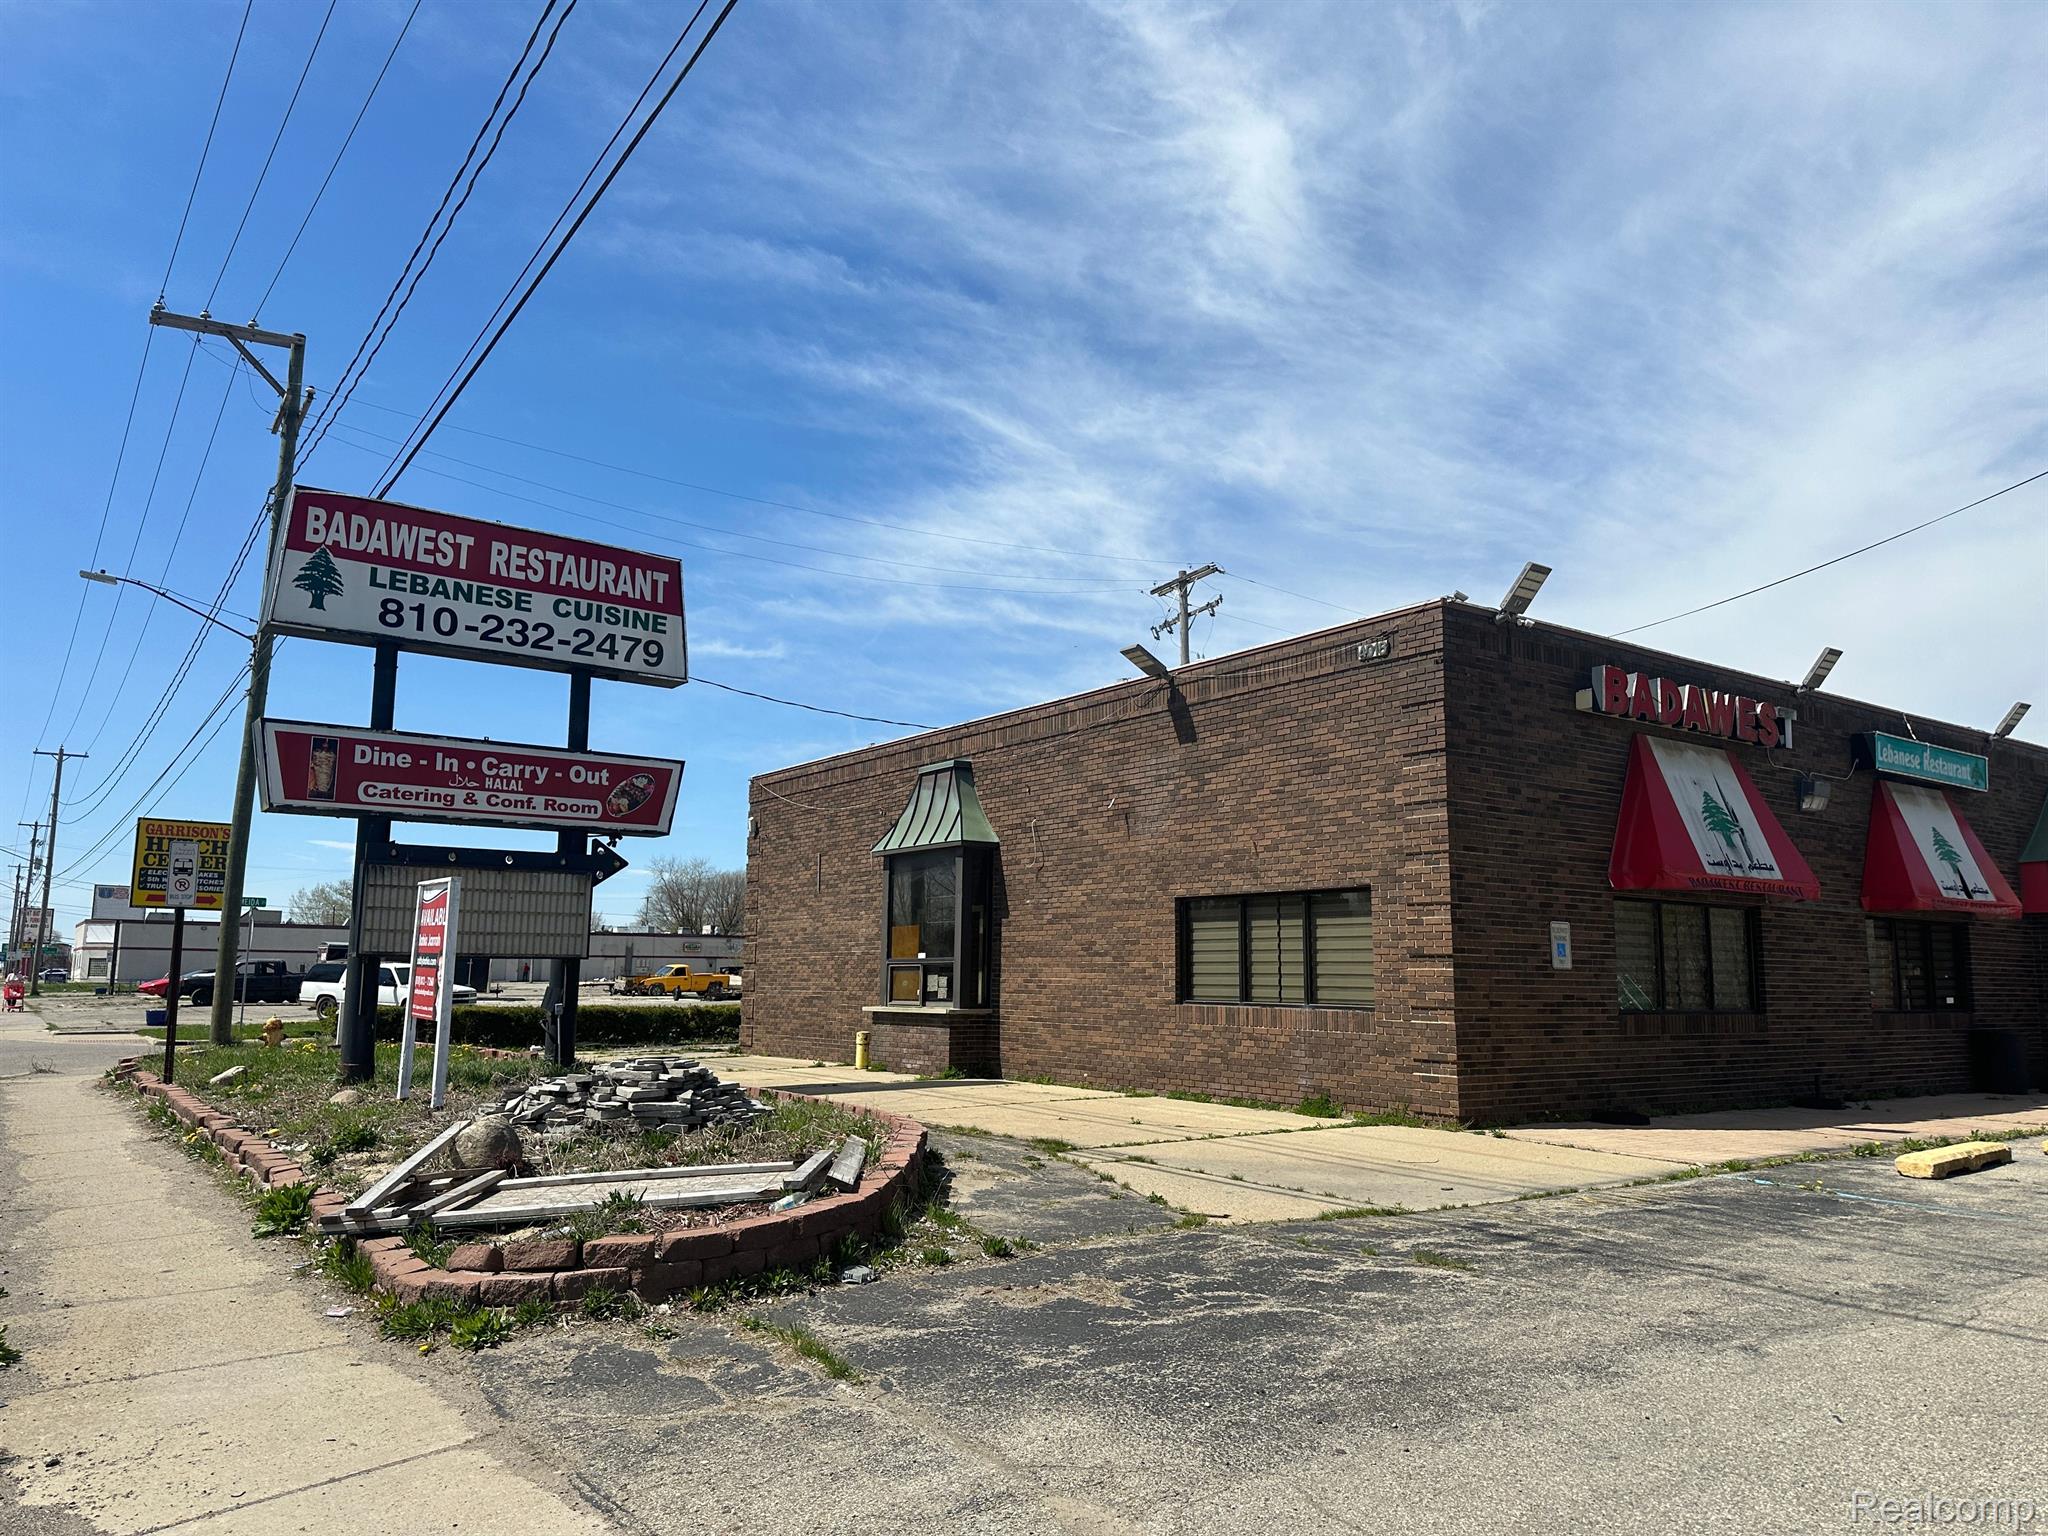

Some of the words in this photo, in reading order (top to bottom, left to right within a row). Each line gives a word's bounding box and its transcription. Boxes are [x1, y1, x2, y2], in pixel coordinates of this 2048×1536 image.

[305, 505, 475, 570] BADAWEST
[489, 541, 669, 604] RESTAURANT
[369, 566, 533, 613] LEBANESE
[552, 598, 668, 635] CUISINE
[378, 597, 664, 668] 810-232-2479
[1602, 664, 1798, 749] BADAWEST
[354, 744, 412, 768] Dine
[435, 752, 459, 772] In
[481, 756, 549, 785] Carry
[569, 765, 610, 786] Out
[1877, 740, 1921, 770] Lebanese
[1923, 751, 1973, 781] Restaurant
[448, 773, 480, 787] حلال
[485, 777, 524, 792] HALAL
[362, 784, 456, 807] Catering
[463, 792, 478, 806] &
[486, 794, 537, 810] Conf.
[543, 798, 599, 815] Room
[145, 823, 231, 840] GARRISON'S
[143, 852, 228, 870] CEER
[421, 907, 446, 927] AVAILABL
